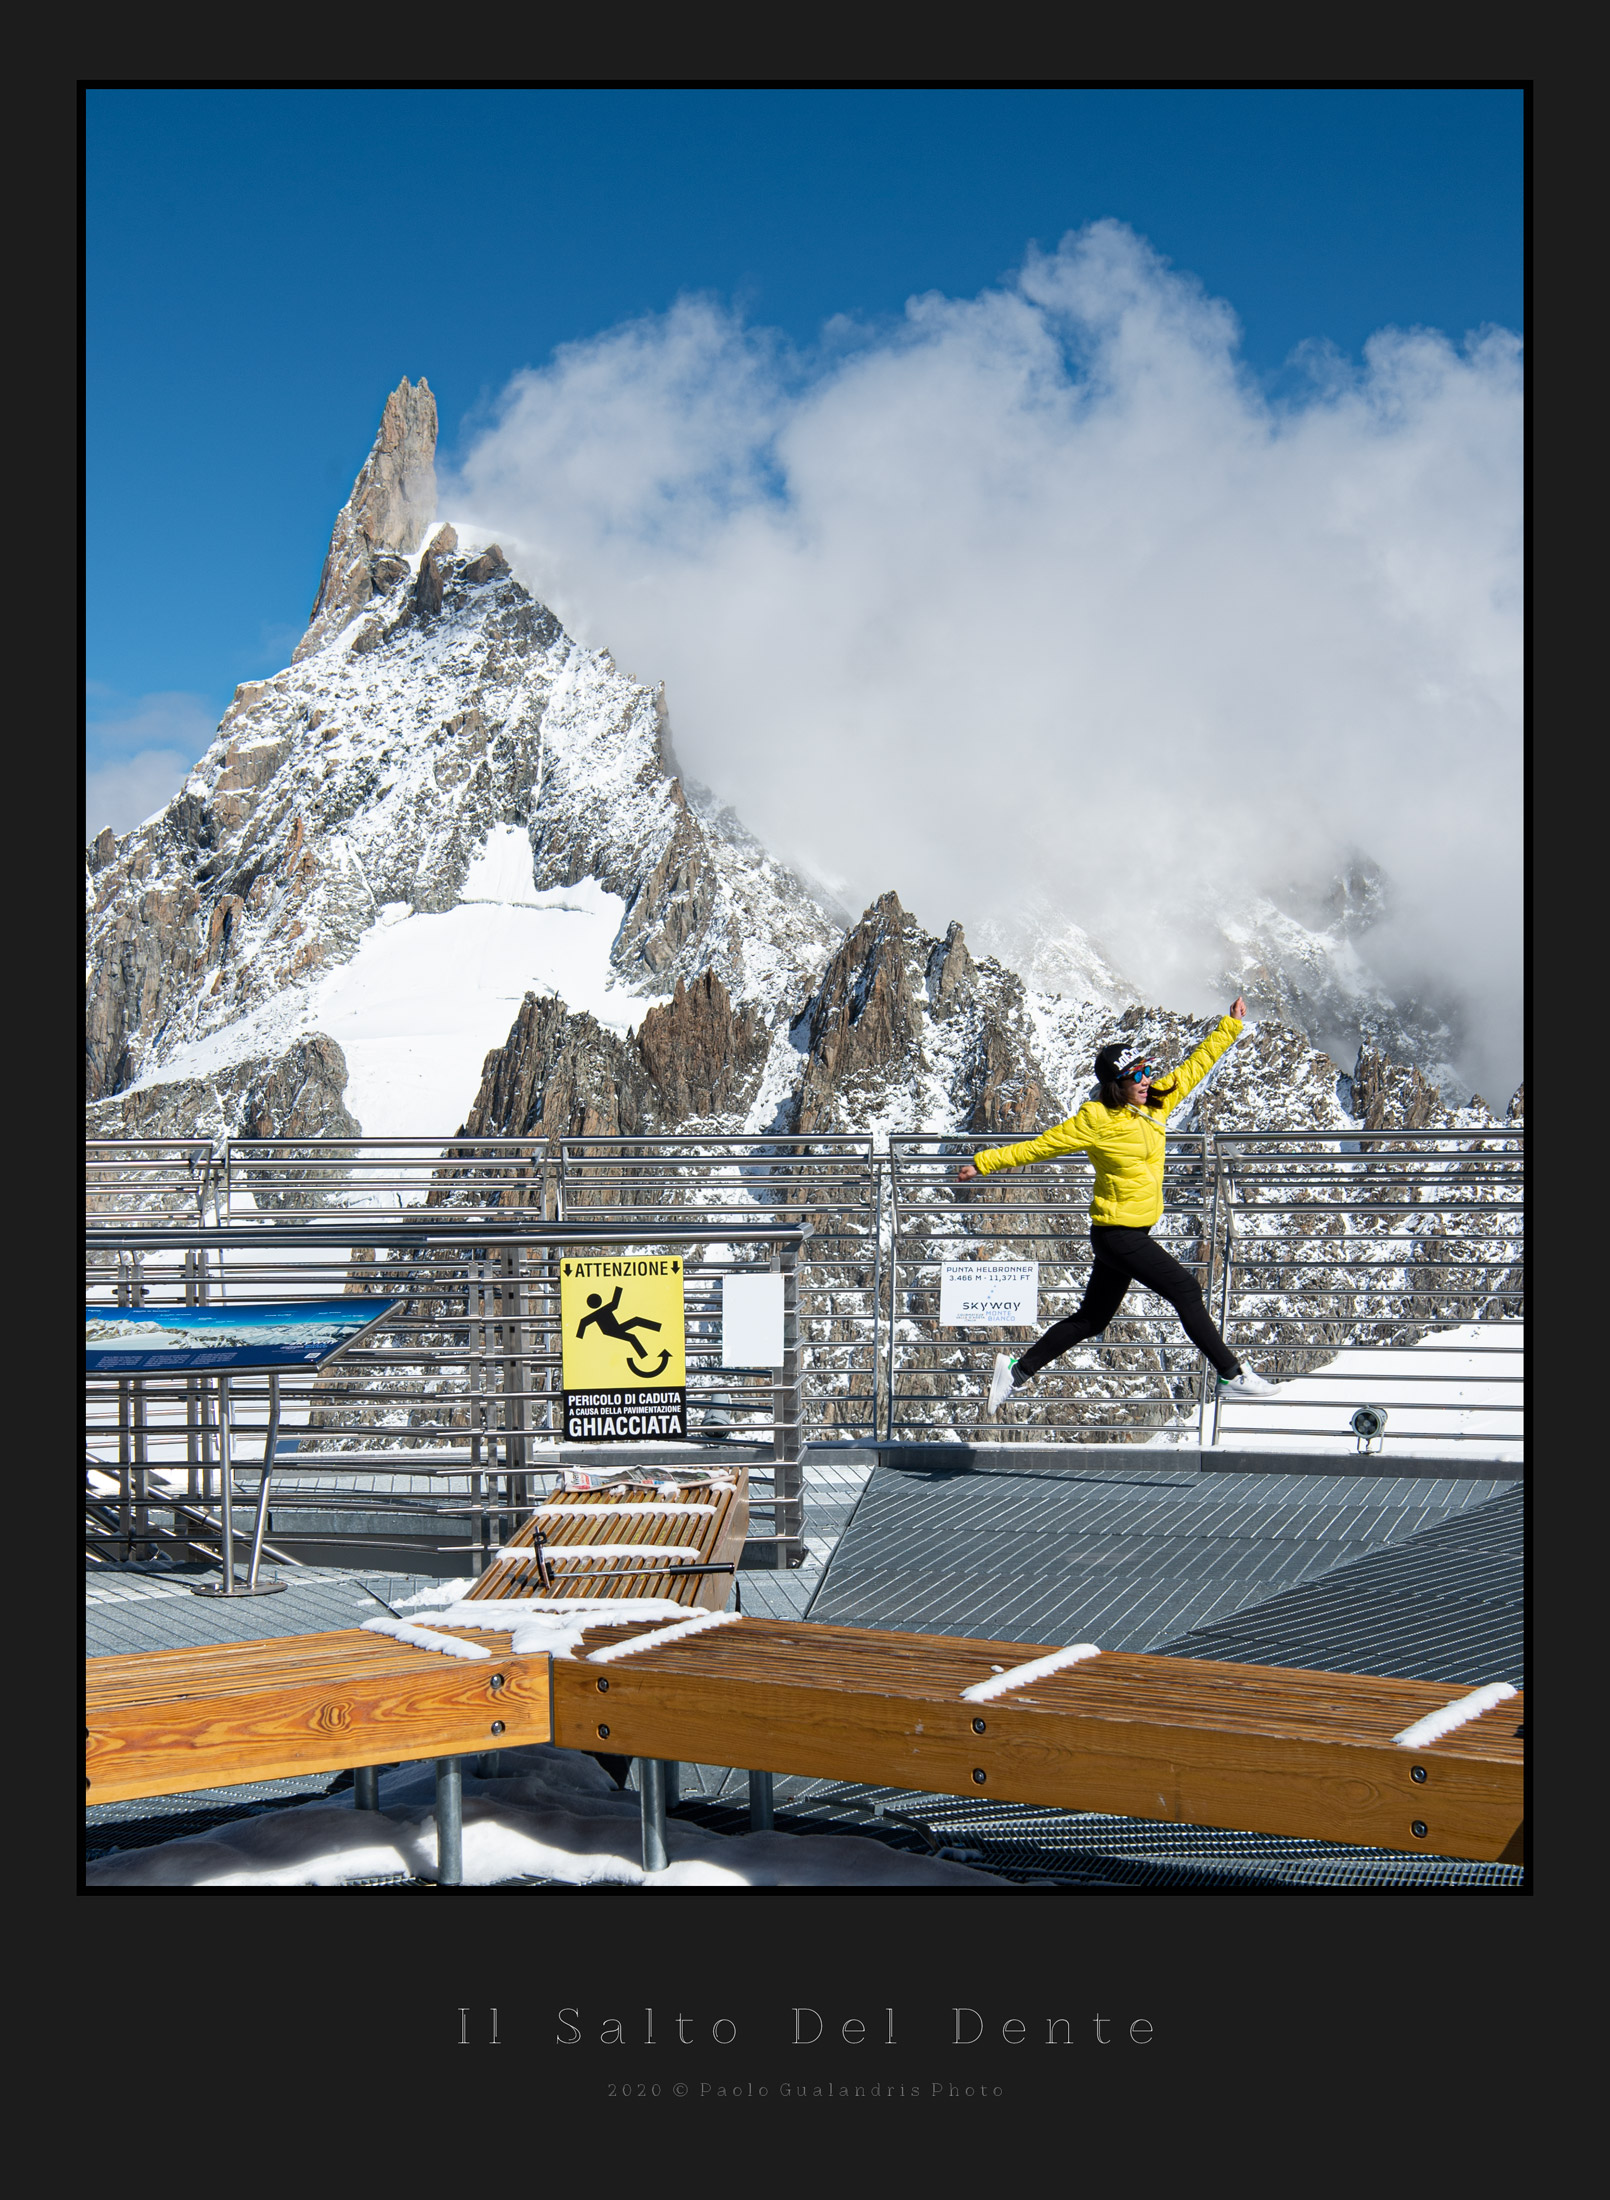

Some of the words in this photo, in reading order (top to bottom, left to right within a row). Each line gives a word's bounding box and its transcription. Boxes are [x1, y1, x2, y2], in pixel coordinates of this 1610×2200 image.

[575, 1261, 668, 1278] ATTENZIONE
[568, 1393, 622, 1407] PERICOLO
[624, 1393, 636, 1405] DI
[639, 1392, 681, 1405] CADUTA
[575, 1407, 599, 1415] CAUSA
[600, 1406, 623, 1415] DELLA
[623, 1405, 681, 1414] PAVIMENTAZIONE
[569, 1415, 682, 1437] GHIACCIATA
